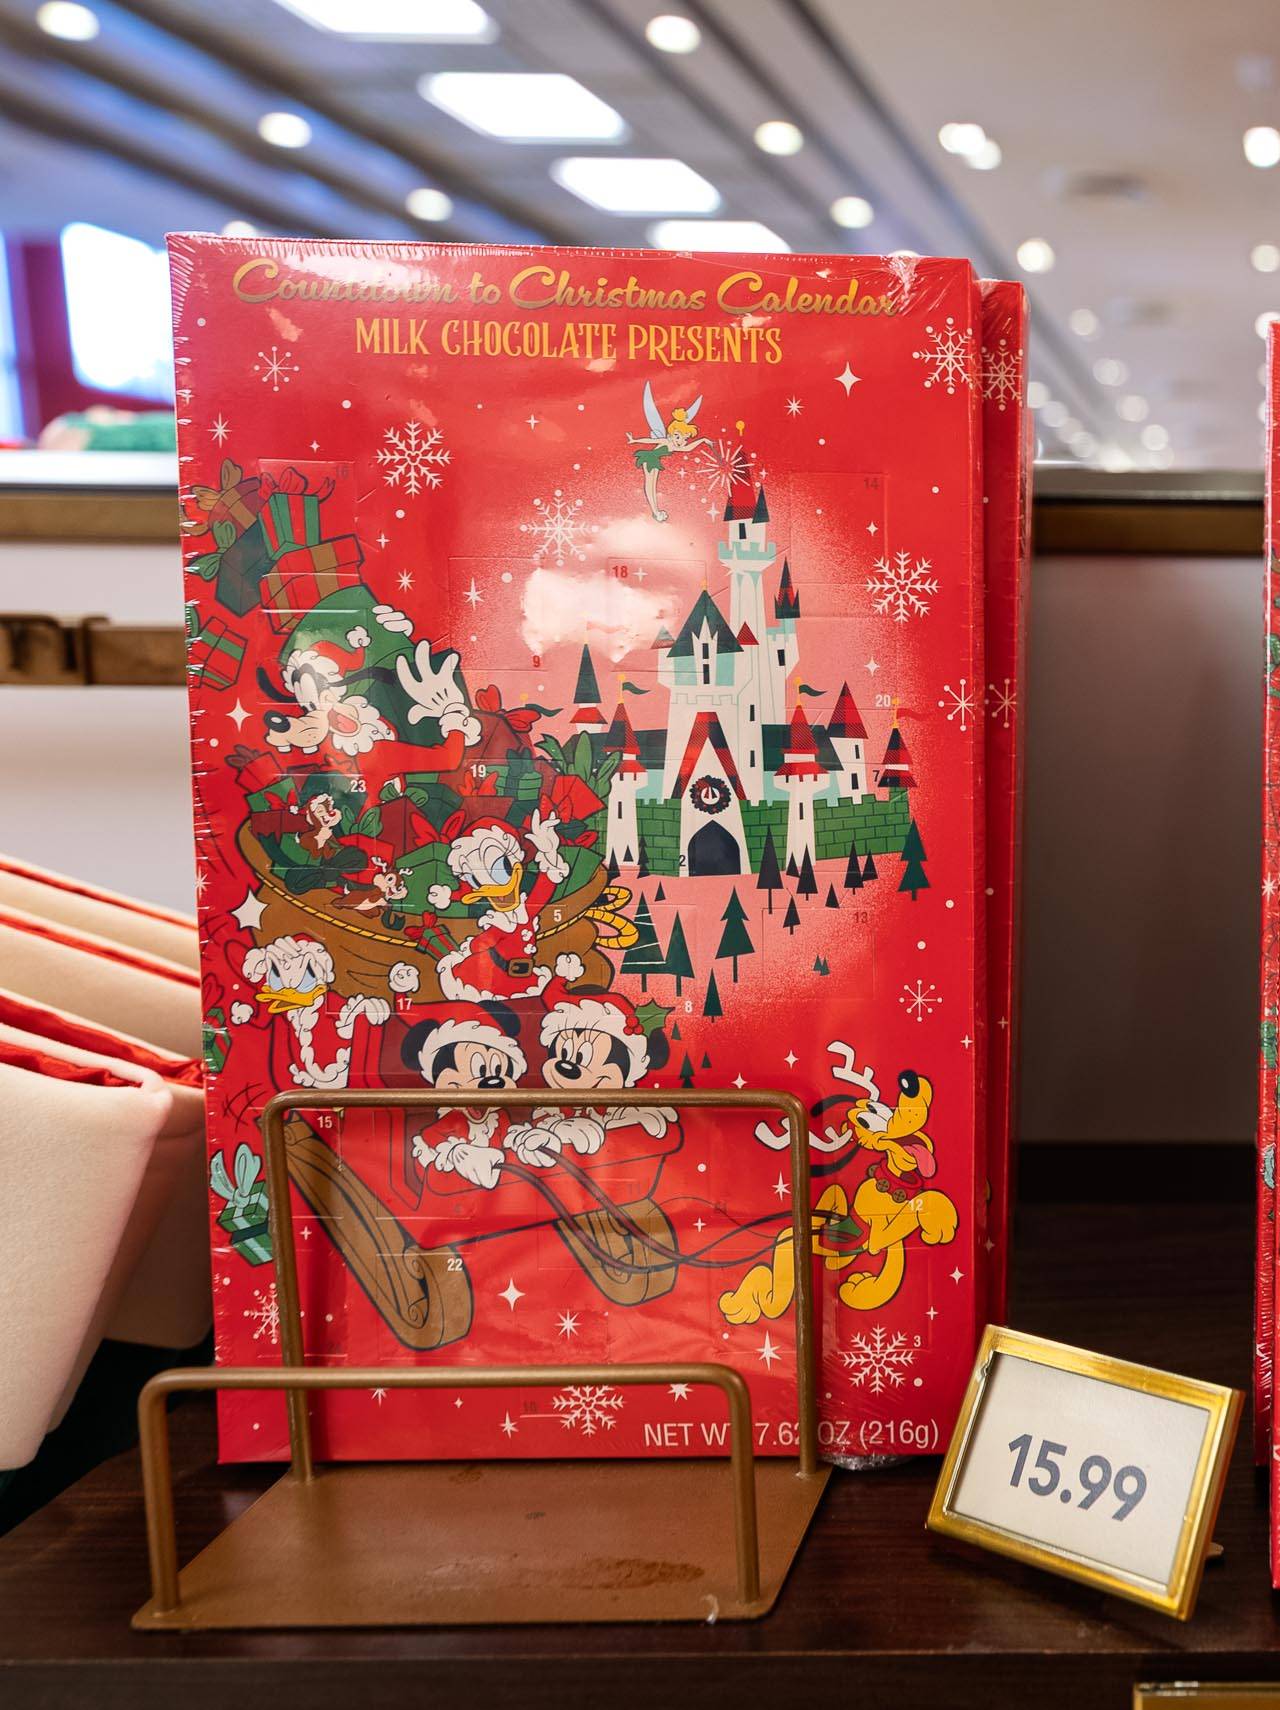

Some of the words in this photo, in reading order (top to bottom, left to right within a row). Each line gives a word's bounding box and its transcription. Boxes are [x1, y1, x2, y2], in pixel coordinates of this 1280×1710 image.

[471, 272, 501, 305] to
[509, 265, 706, 310] Christmas
[717, 271, 899, 316] Calendar
[356, 317, 430, 354] MILK
[441, 319, 617, 361] CHOCOLATE
[628, 323, 783, 367] PRESENTS
[863, 477, 880, 490] 14
[611, 565, 629, 579] 18
[532, 655, 541, 668] 9
[875, 693, 892, 708] 20
[470, 764, 488, 779] 19
[872, 769, 881, 783] 7
[350, 779, 367, 794] 23
[679, 854, 687, 868] 2
[553, 909, 562, 923] 5
[853, 911, 869, 925] 13
[397, 997, 413, 1012] 17
[684, 1000, 693, 1014] 8
[316, 1116, 333, 1130] 15
[909, 1198, 924, 1213] 12
[447, 1258, 464, 1273] 22
[912, 1335, 922, 1349] 3
[644, 1422, 693, 1447] NET
[818, 1420, 850, 1445] OZ
[860, 1419, 940, 1449] (216g)
[1008, 1433, 1147, 1522] 15.99
